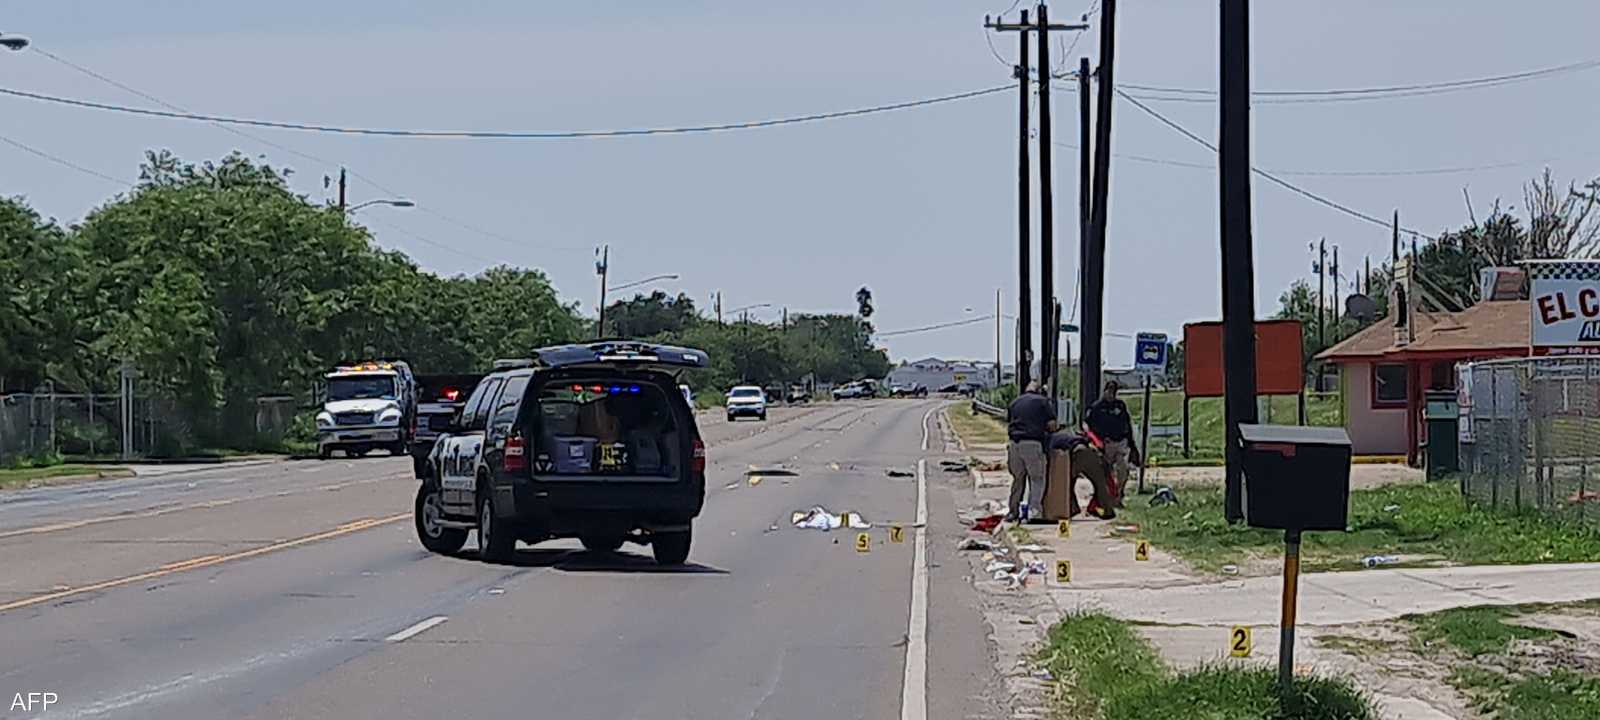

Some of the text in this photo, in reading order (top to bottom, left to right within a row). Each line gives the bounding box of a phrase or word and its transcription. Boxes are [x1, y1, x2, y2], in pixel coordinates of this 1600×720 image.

[1536, 292, 1577, 326] EL
[1136, 541, 1147, 557] 4
[1058, 562, 1068, 578] 3
[1233, 628, 1247, 651] 2
